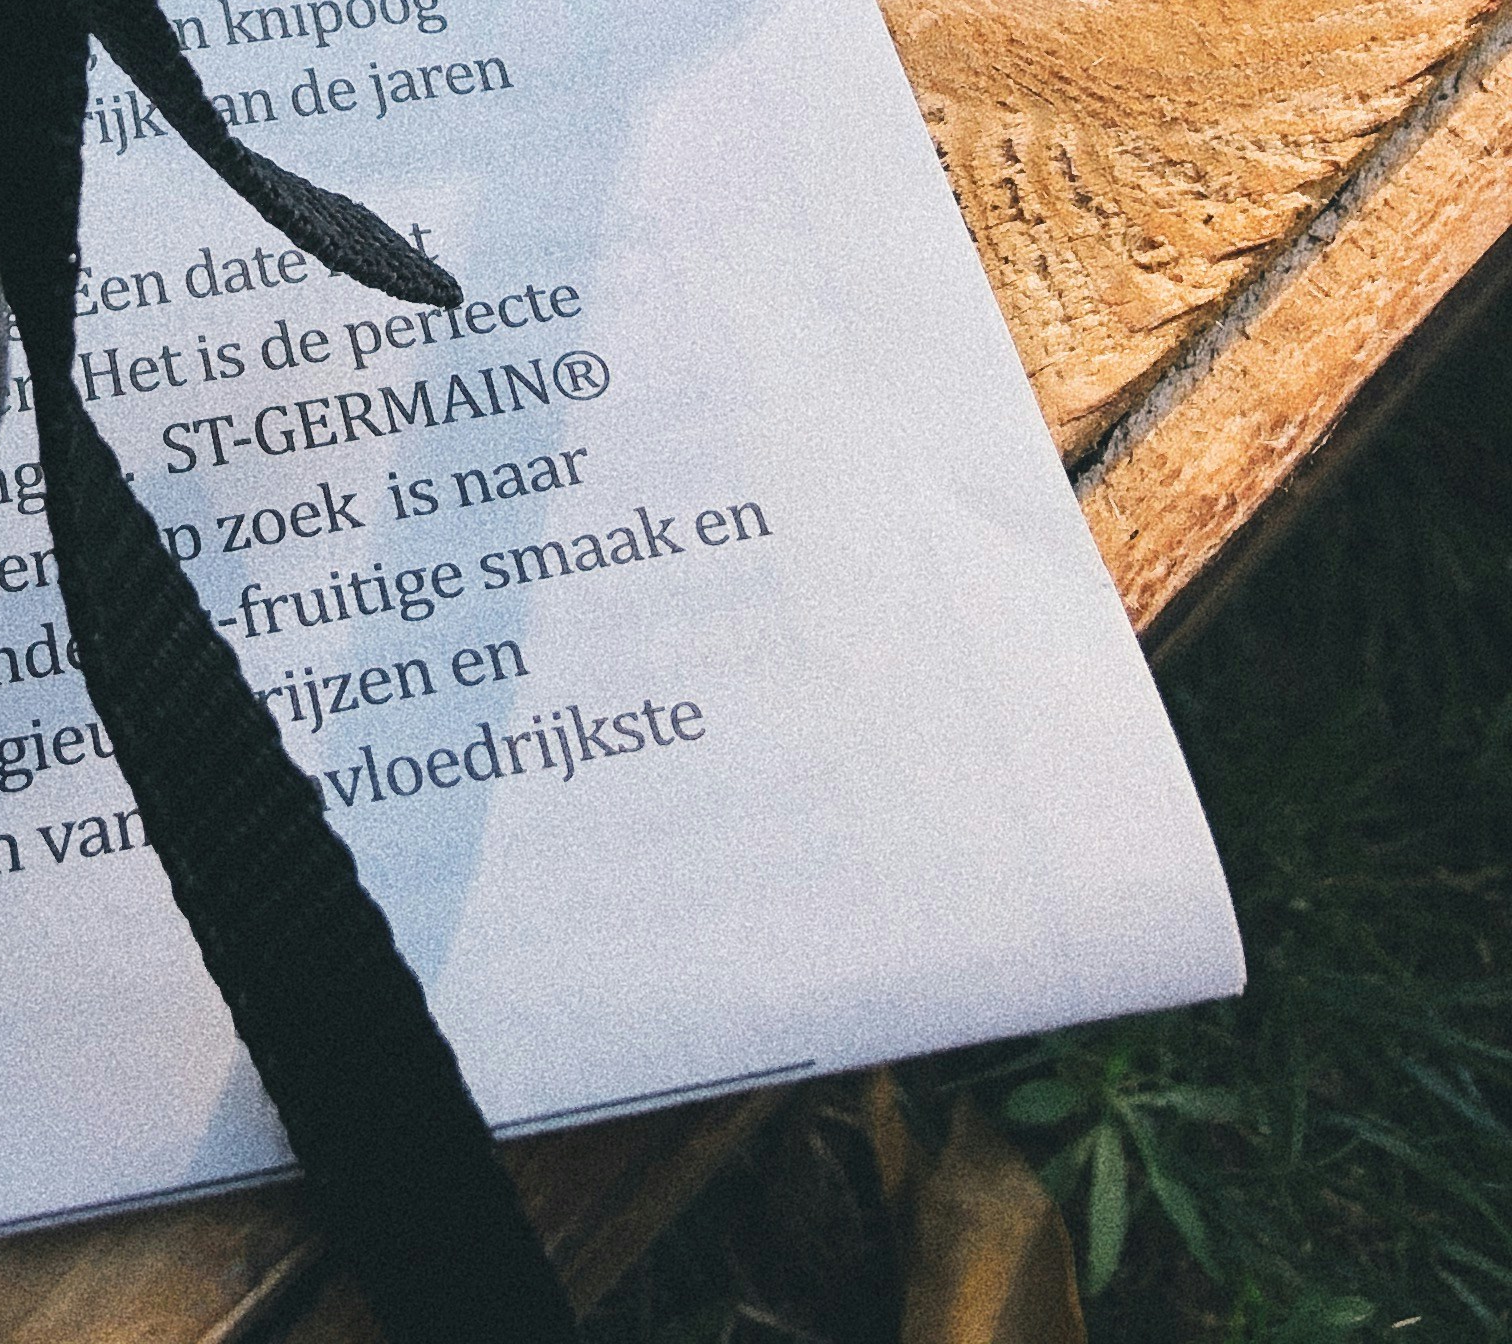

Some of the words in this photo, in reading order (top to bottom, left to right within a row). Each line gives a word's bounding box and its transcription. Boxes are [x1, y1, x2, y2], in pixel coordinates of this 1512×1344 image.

[87, 90, 169, 156] ijk
[290, 68, 357, 118] de
[368, 55, 515, 120] jaren
[184, 246, 309, 299] date
[78, 345, 188, 402] Het
[197, 334, 246, 382] is
[261, 319, 332, 371] de
[216, 482, 366, 553] zoek
[388, 471, 439, 521] is
[450, 447, 588, 508] naar
[479, 506, 686, 590] smaak
[695, 501, 774, 547] en
[451, 637, 530, 687] en
[36, 807, 152, 864] van
